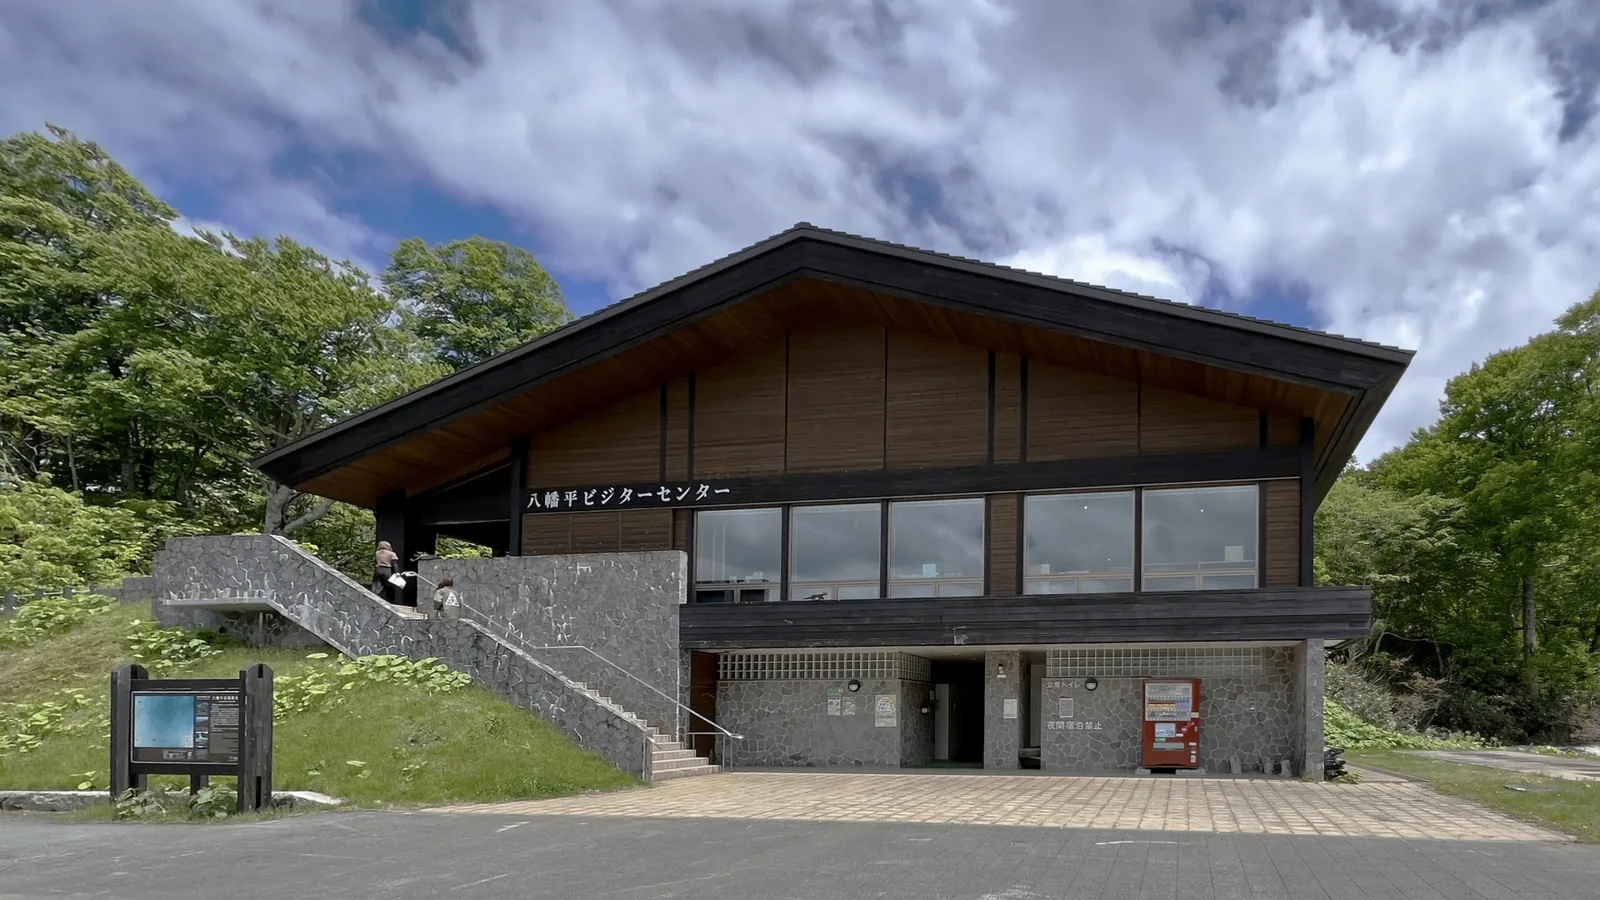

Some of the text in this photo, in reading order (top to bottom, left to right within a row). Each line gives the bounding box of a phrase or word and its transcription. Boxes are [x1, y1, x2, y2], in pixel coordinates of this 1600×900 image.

[526, 483, 731, 509] 八幡平ビジターセンター
[1047, 720, 1103, 730] 夜間宿泊禁止
